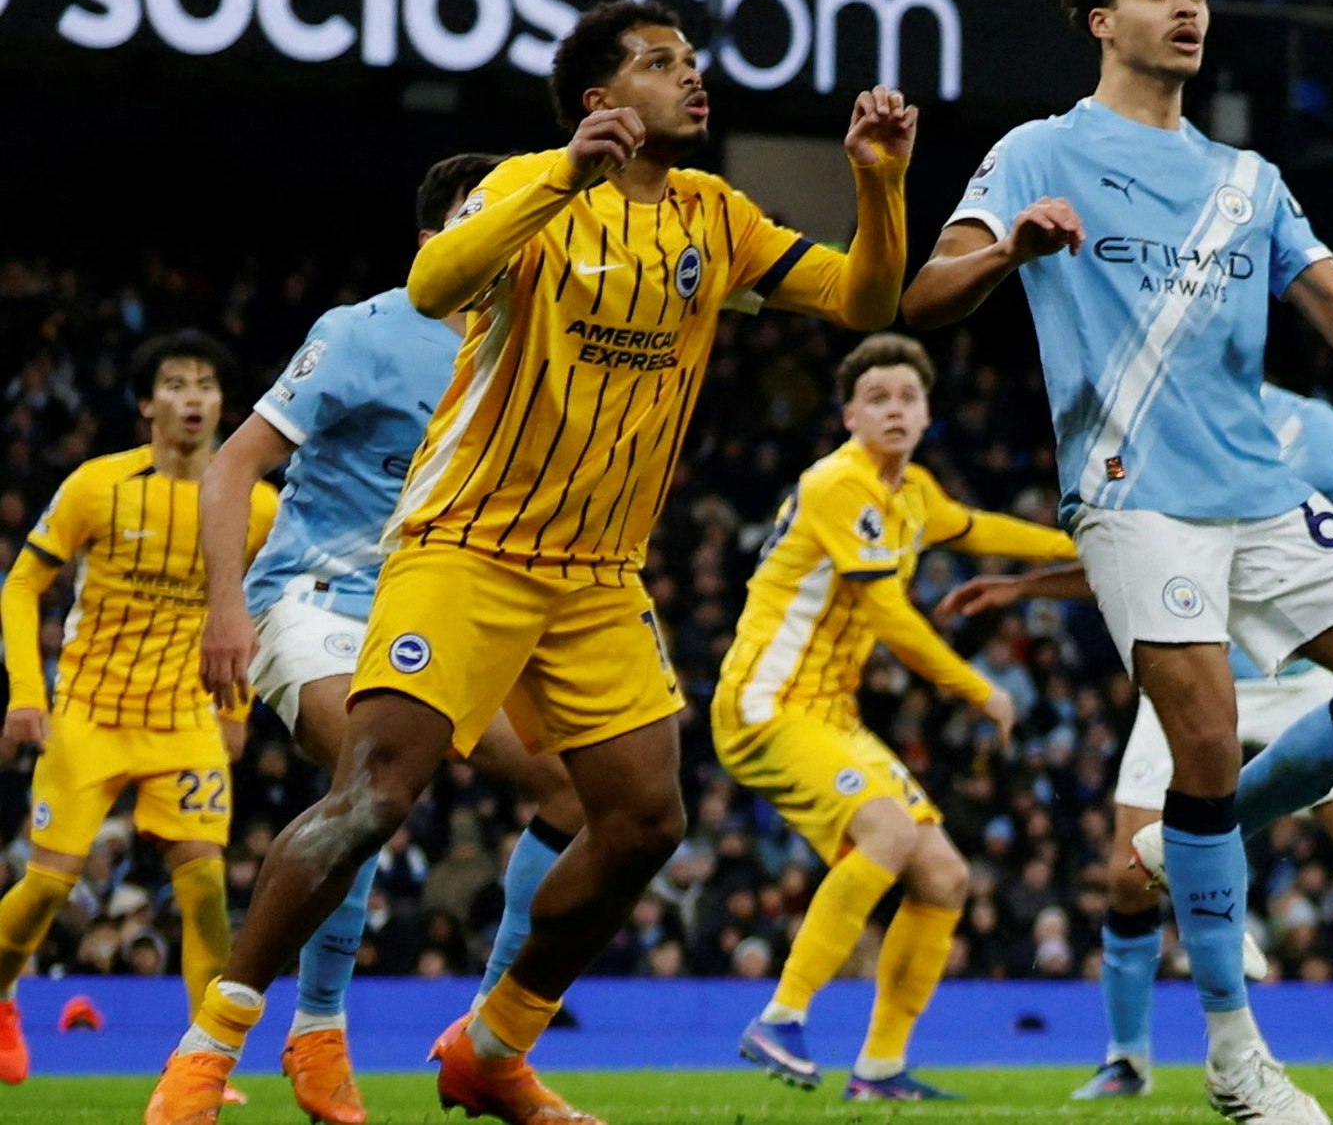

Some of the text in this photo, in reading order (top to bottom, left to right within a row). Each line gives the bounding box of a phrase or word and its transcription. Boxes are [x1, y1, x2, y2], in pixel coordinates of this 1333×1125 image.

[1094, 236, 1254, 280] ETIHAD
[1139, 276, 1228, 303] AIRWAYS
[177, 771, 227, 813] 22
